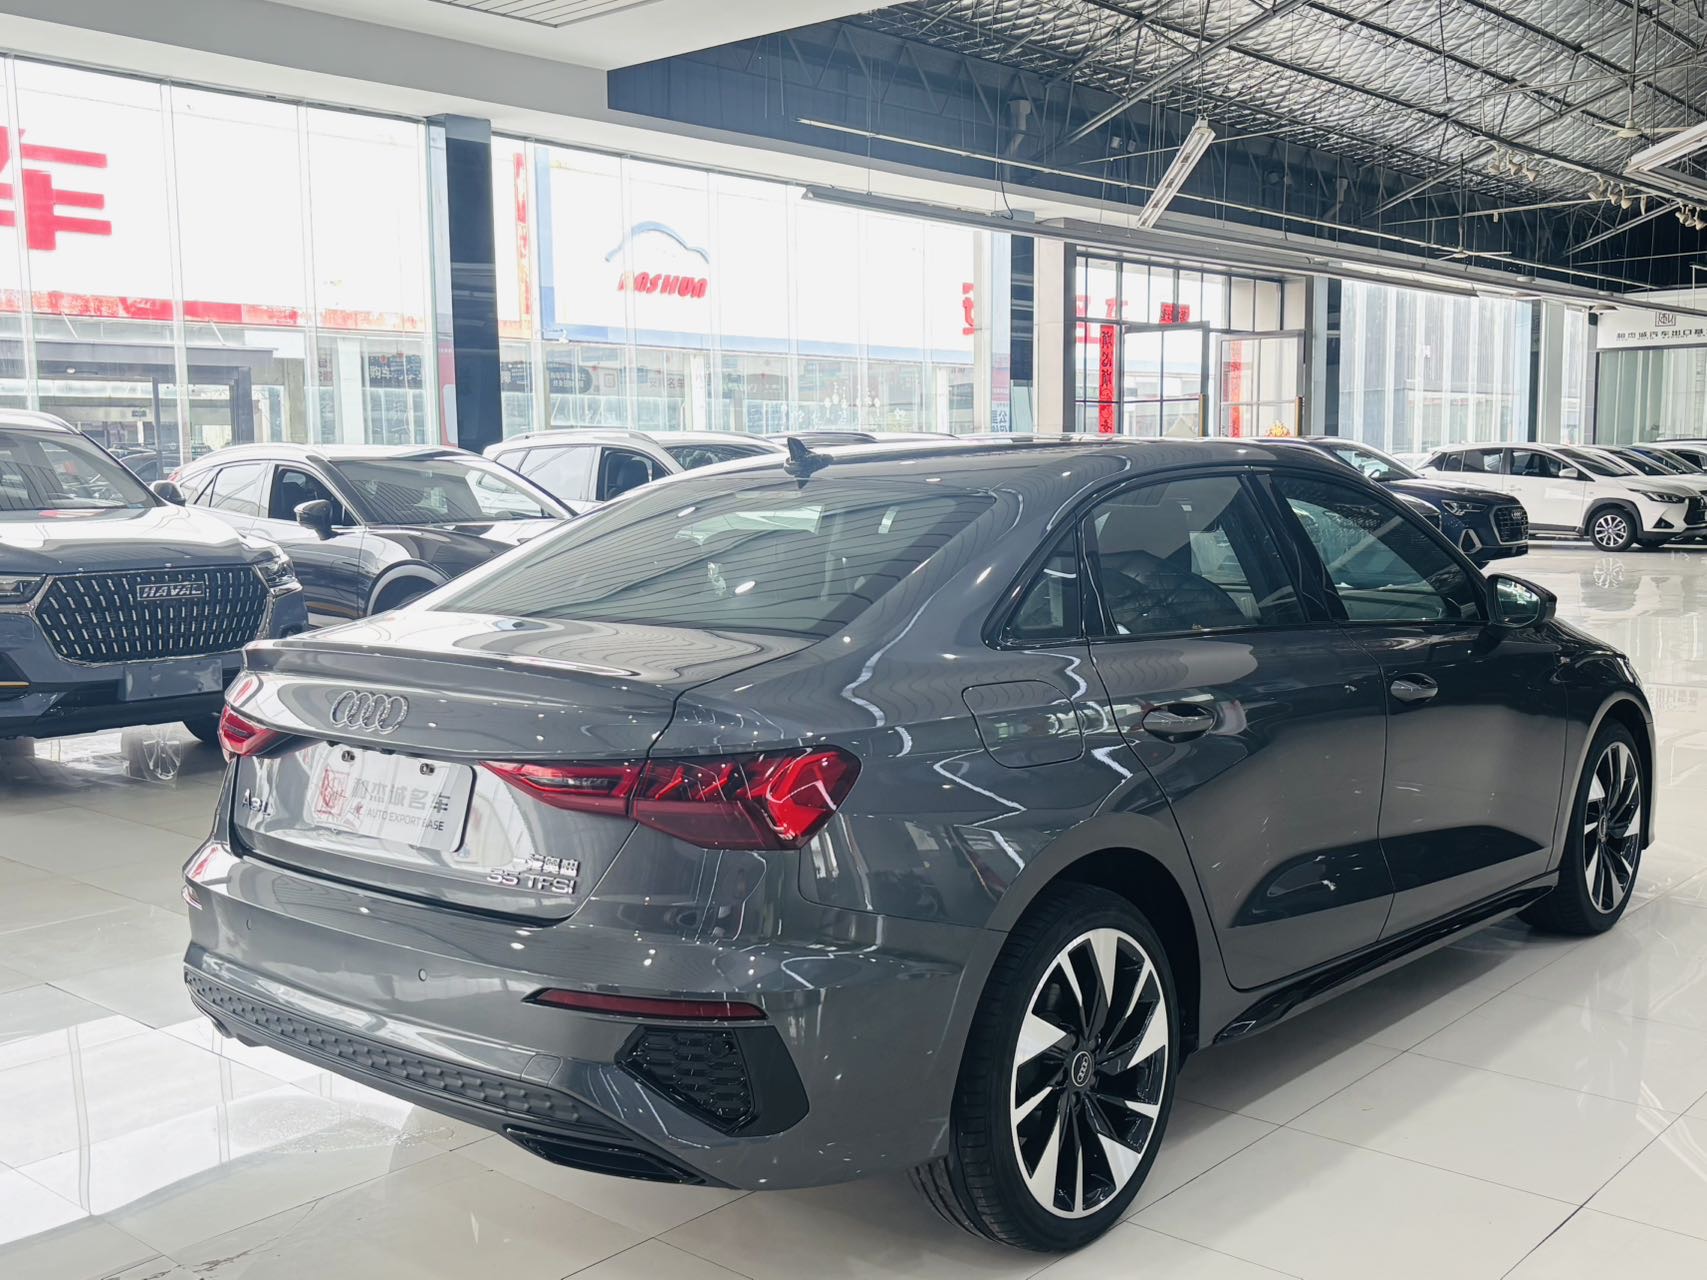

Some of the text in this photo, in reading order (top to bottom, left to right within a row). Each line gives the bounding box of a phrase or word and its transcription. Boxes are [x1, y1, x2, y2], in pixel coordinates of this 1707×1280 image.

[143, 584, 202, 598] HAVAL
[367, 807, 388, 821] AUTO
[388, 812, 422, 828] EXPORT
[423, 817, 445, 831] BASE
[525, 873, 575, 895] TFSI
